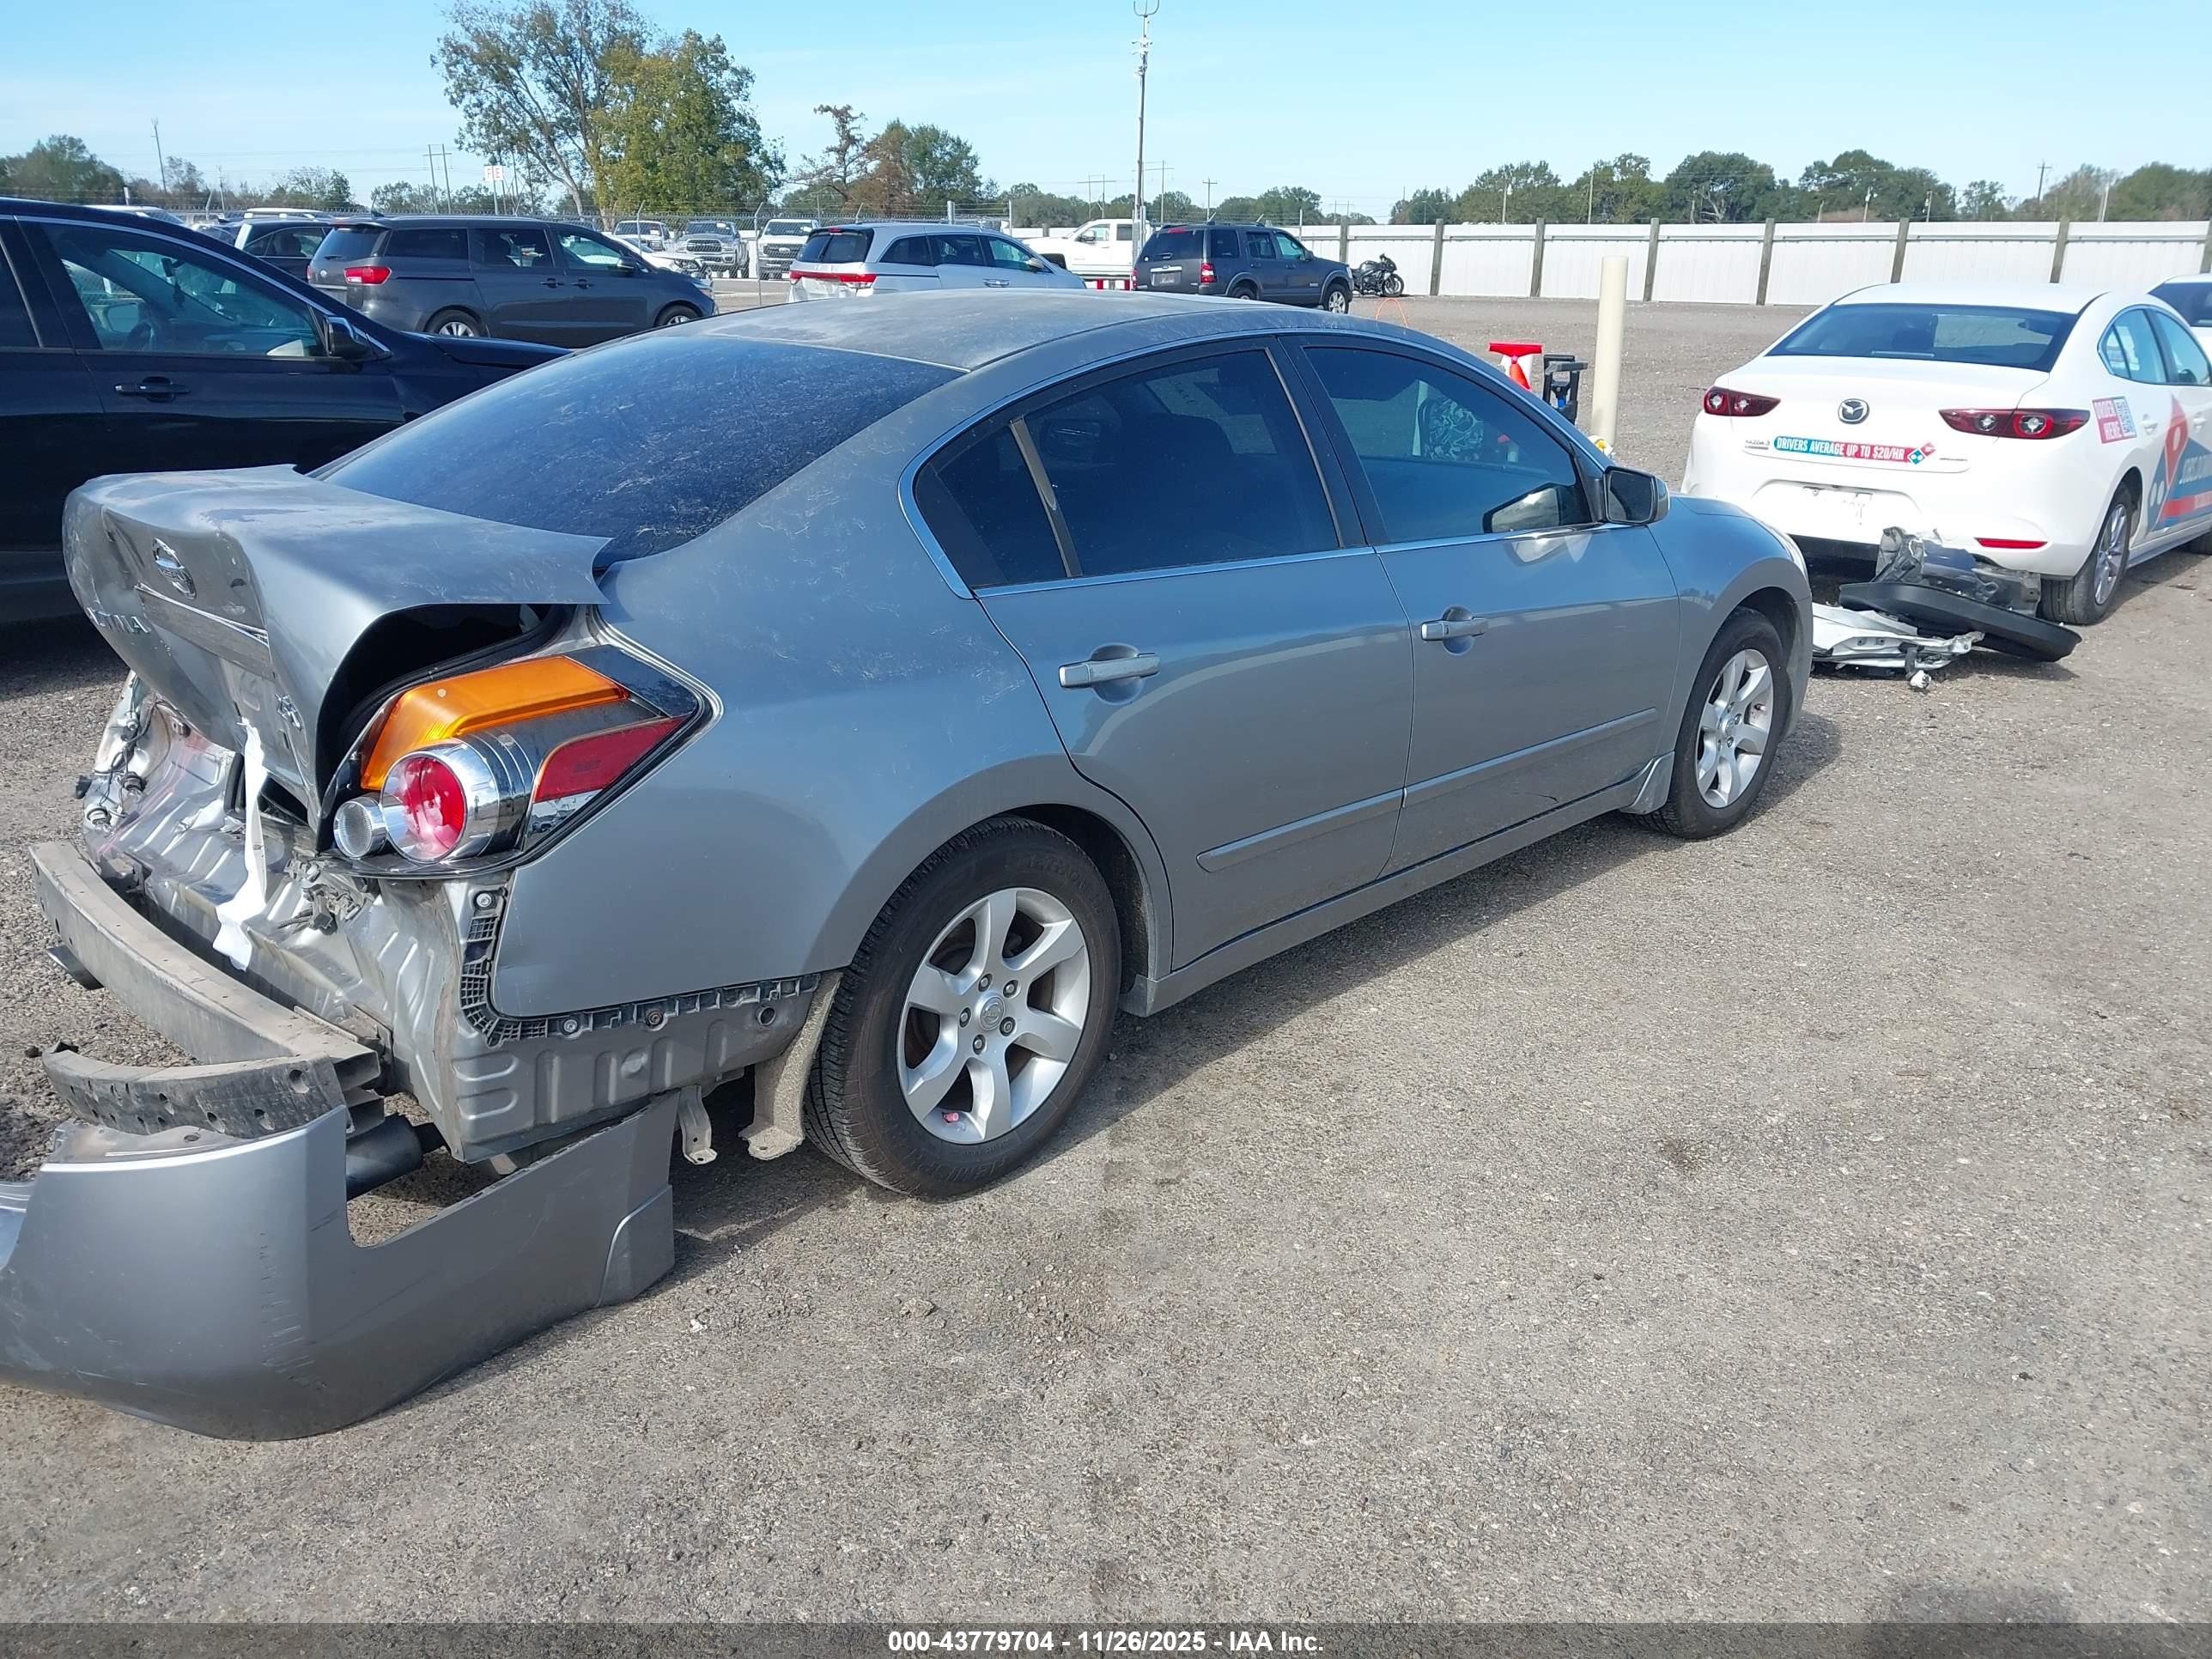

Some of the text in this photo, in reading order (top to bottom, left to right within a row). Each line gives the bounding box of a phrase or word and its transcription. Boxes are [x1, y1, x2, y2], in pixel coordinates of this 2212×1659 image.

[1776, 437, 1905, 460] DRIVERS AVERAGE UP TO $20/HR
